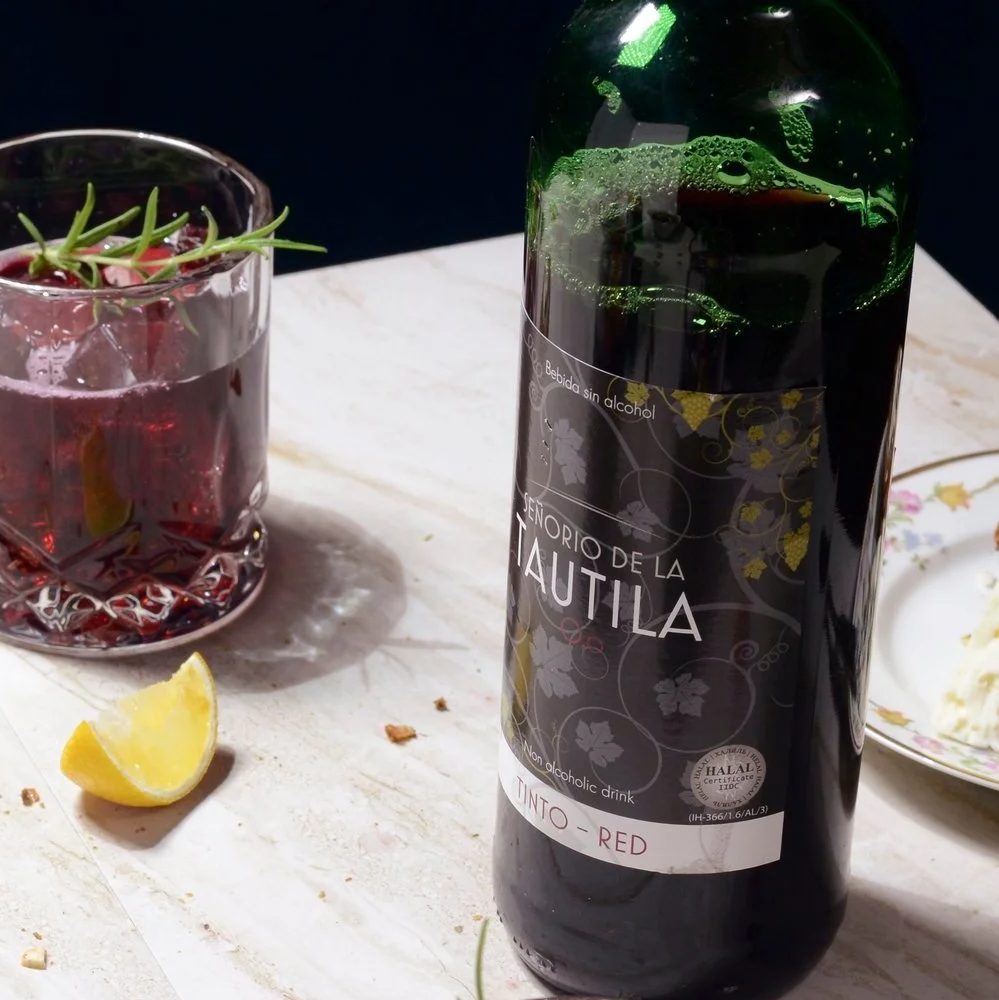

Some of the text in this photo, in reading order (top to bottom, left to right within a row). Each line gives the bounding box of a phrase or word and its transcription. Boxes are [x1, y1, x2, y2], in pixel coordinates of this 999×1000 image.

[545, 360, 656, 420] Bebida sin alcohol
[523, 492, 685, 581] SEÑORIO DE LA
[516, 512, 702, 642] TAUTILA
[523, 740, 635, 805] Non alcoholic drink
[703, 774, 754, 785] Certificate
[705, 762, 755, 777] HALAL
[517, 775, 569, 830] TINTO
[598, 825, 648, 856] RED
